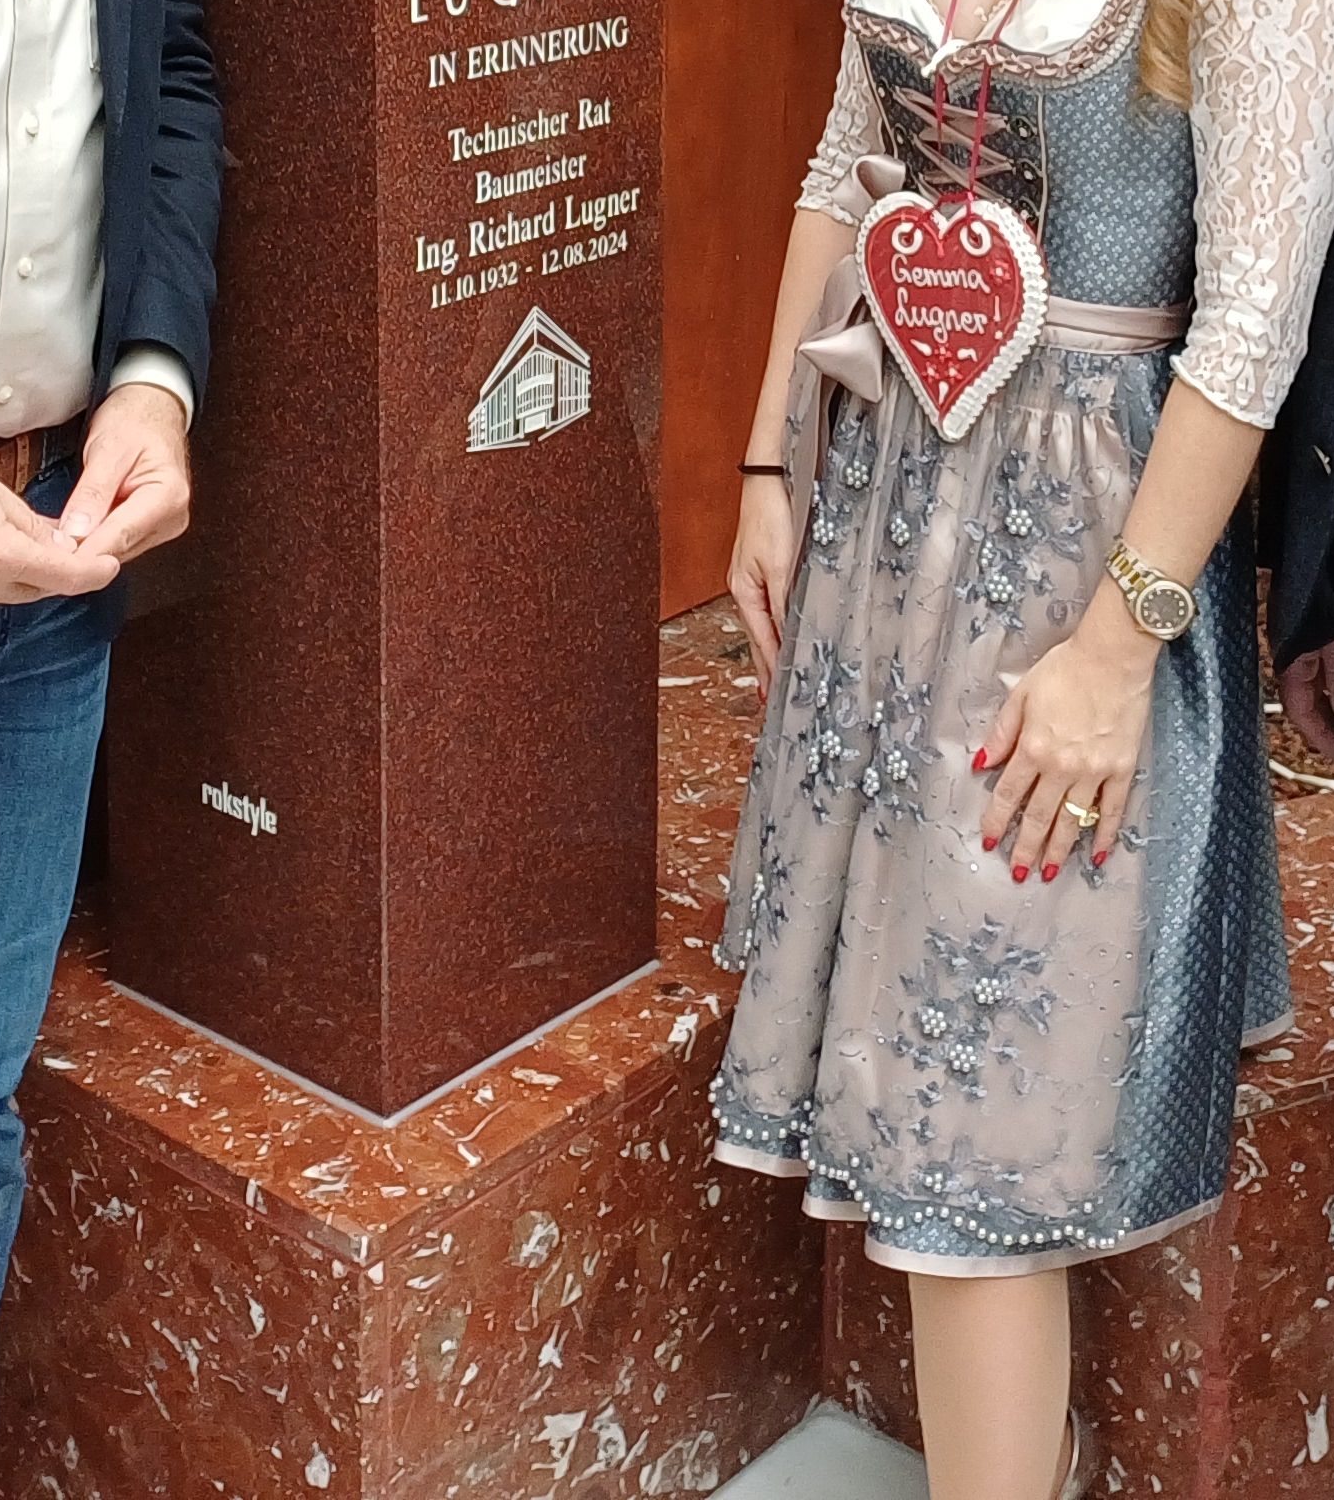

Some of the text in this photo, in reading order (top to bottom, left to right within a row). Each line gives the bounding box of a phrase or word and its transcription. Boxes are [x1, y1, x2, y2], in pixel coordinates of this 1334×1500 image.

[429, 15, 630, 89] IN ERINNERUNG
[447, 96, 612, 162] Technischer Rat
[475, 153, 588, 204] Baumeister
[416, 187, 641, 276] Ing. Richard Lugner
[541, 229, 629, 276] 12.08.2024
[891, 253, 992, 294] Gemma
[201, 781, 279, 837] rokstyle
